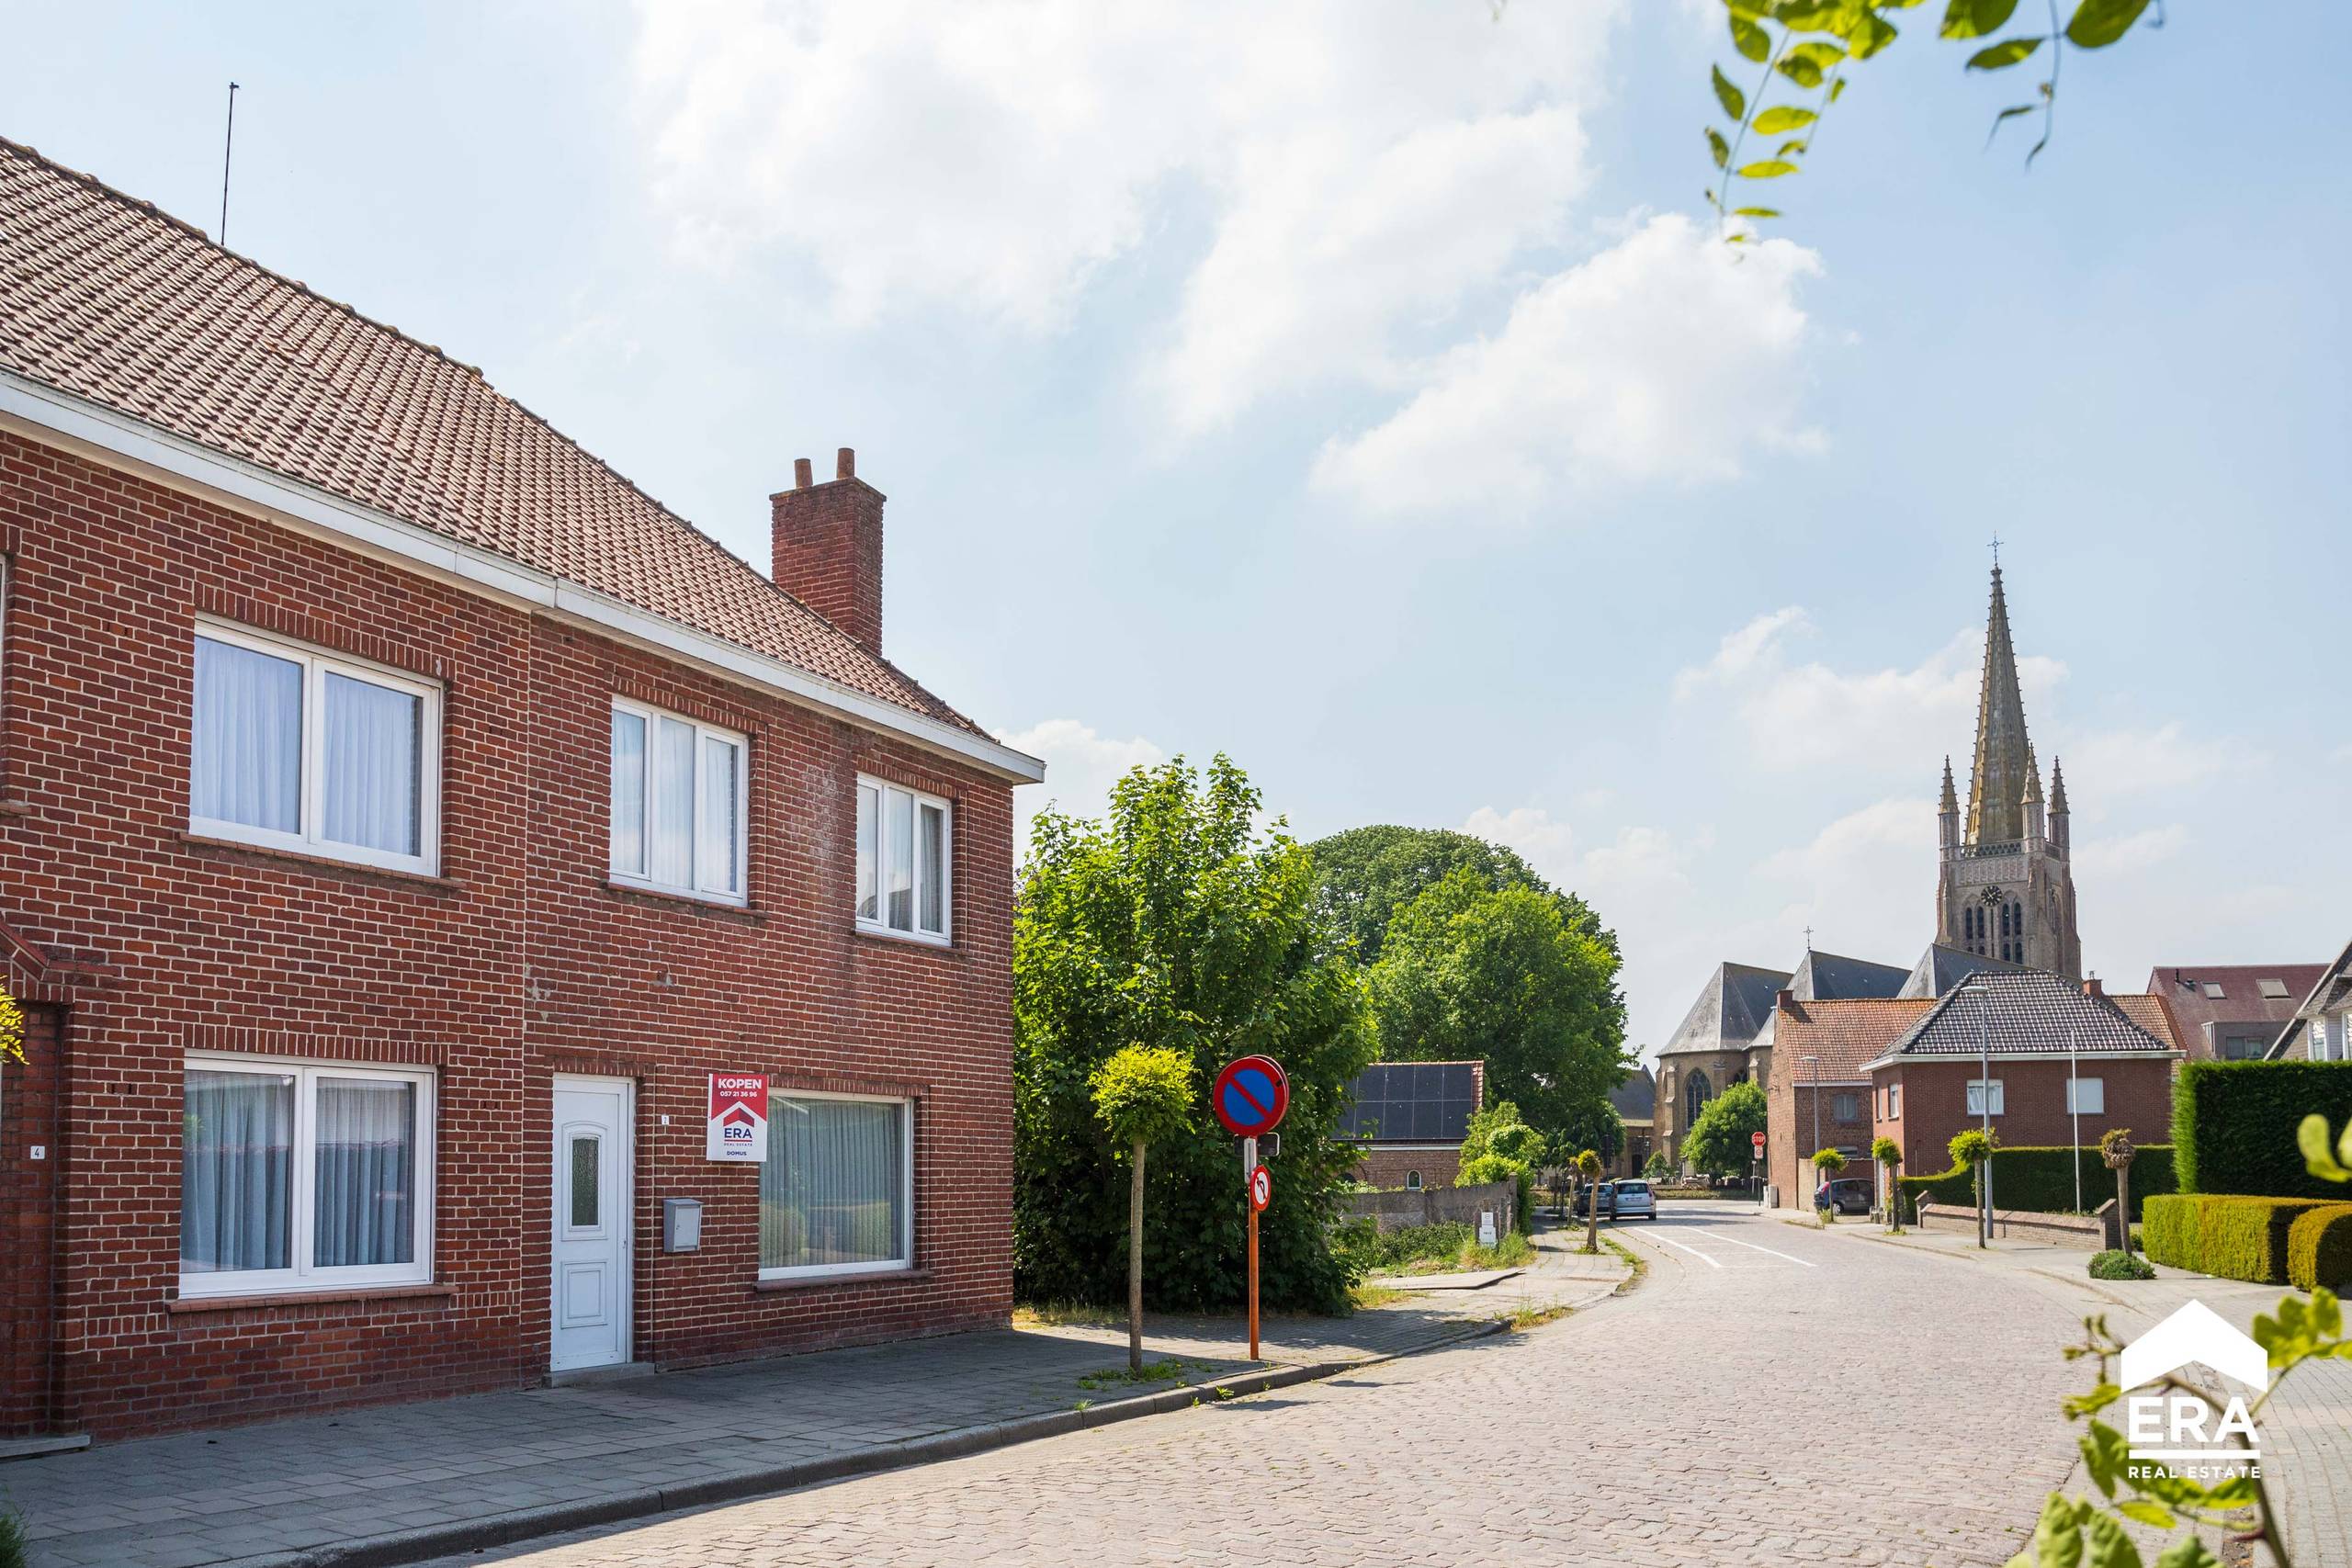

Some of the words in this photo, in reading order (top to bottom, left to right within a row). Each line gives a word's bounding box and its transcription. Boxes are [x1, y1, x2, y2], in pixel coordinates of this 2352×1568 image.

[718, 1078, 762, 1089] KOPEN
[724, 1128, 752, 1139] ERA
[1752, 1135, 1765, 1144] STOP
[34, 1147, 40, 1158] 4
